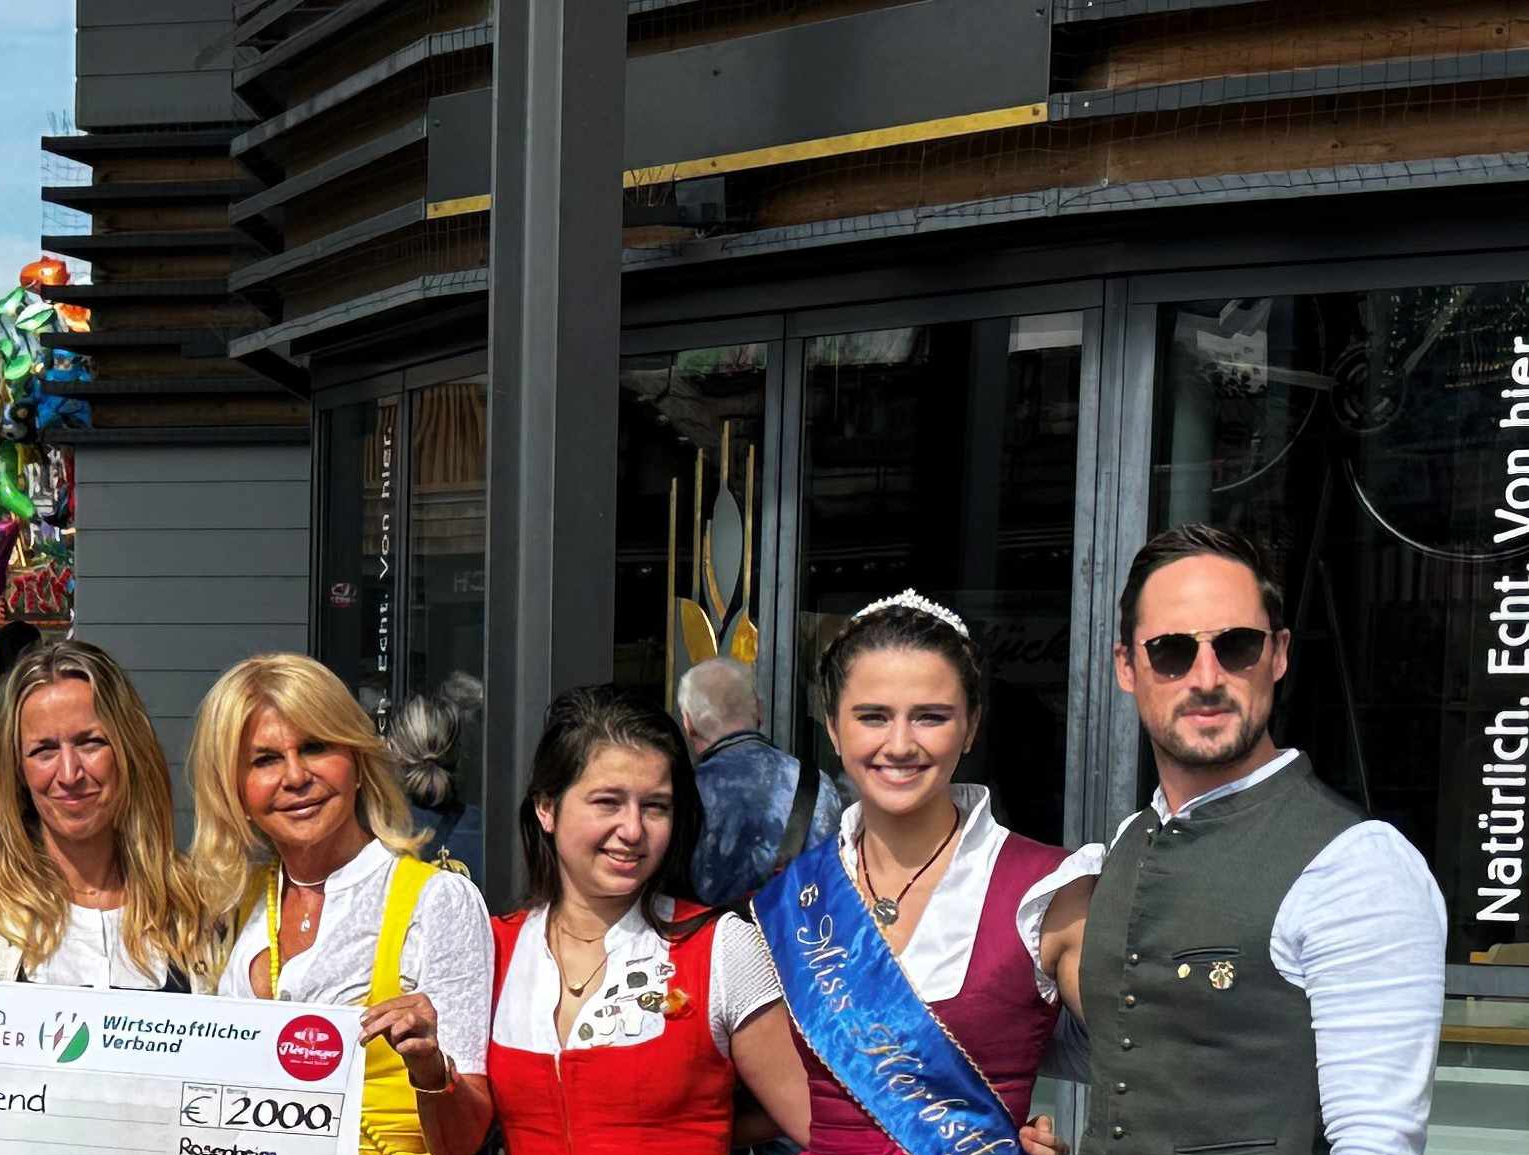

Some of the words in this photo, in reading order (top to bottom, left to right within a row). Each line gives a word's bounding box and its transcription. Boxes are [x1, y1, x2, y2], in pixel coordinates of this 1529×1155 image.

[1493, 449, 1529, 543] Von
[380, 514, 390, 580] Von
[1476, 696, 1529, 922] Natürlich.
[796, 914, 854, 1013] Miss
[102, 1034, 182, 1054] Verband
[103, 1014, 261, 1041] Wirtschaftlicher
[181, 1096, 212, 1124] €
